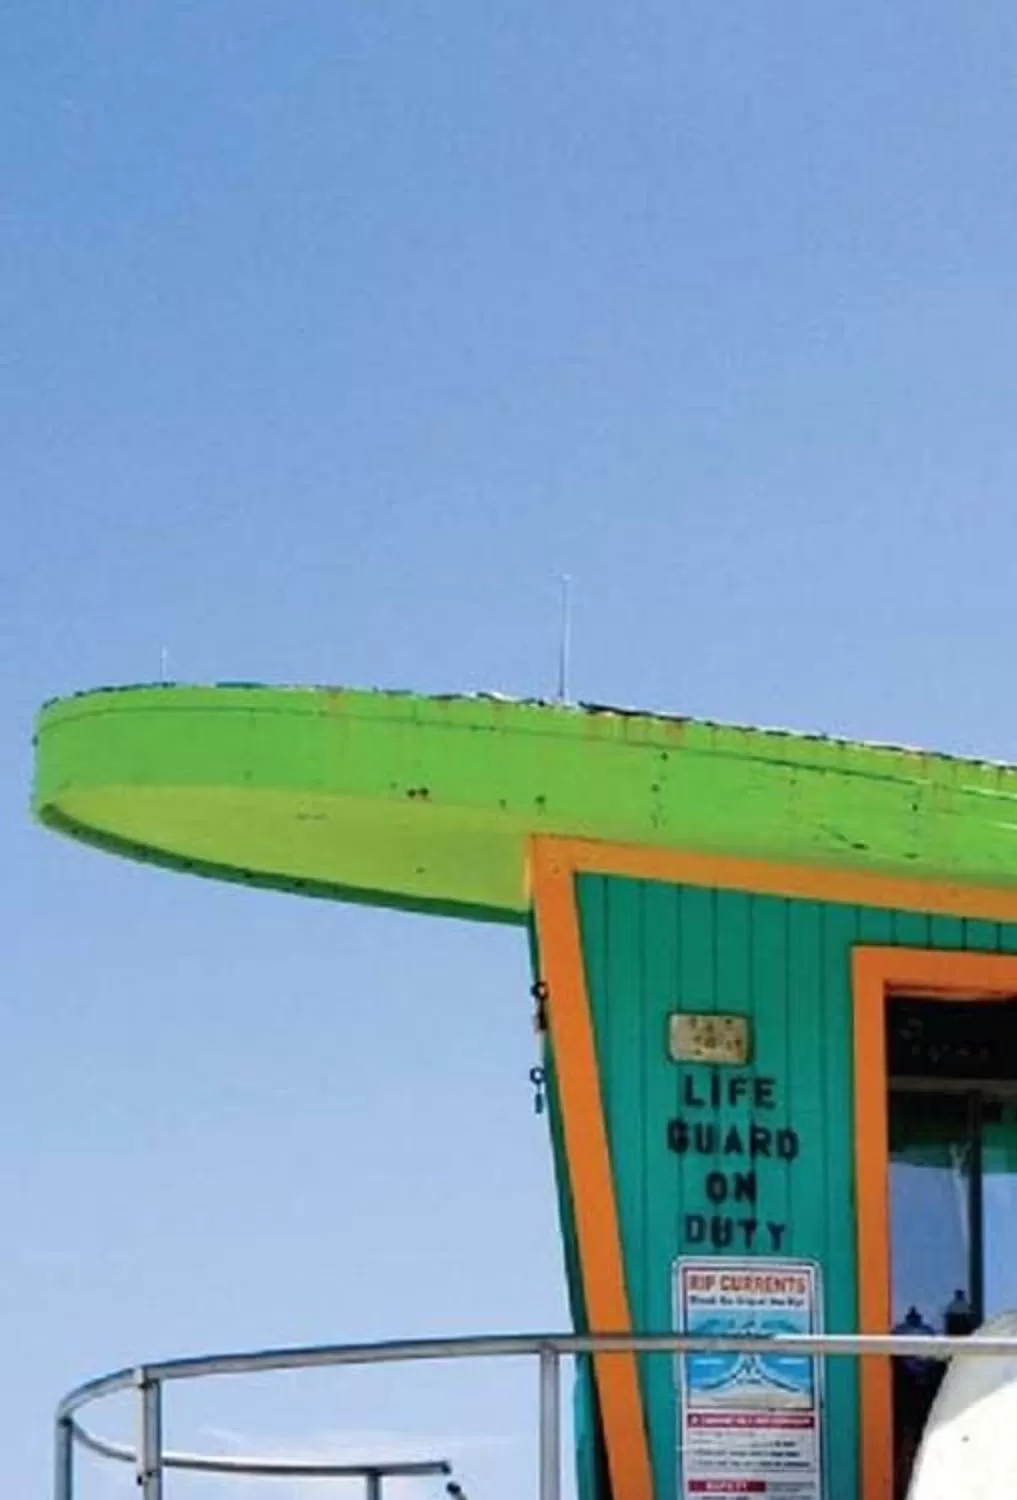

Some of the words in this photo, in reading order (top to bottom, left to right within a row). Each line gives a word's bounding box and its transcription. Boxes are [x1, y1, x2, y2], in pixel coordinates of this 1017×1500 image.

[684, 1074, 775, 1109] LIFE
[667, 1119, 798, 1160] GUARD
[705, 1171, 757, 1204] ON
[685, 1215, 785, 1250] DUTY
